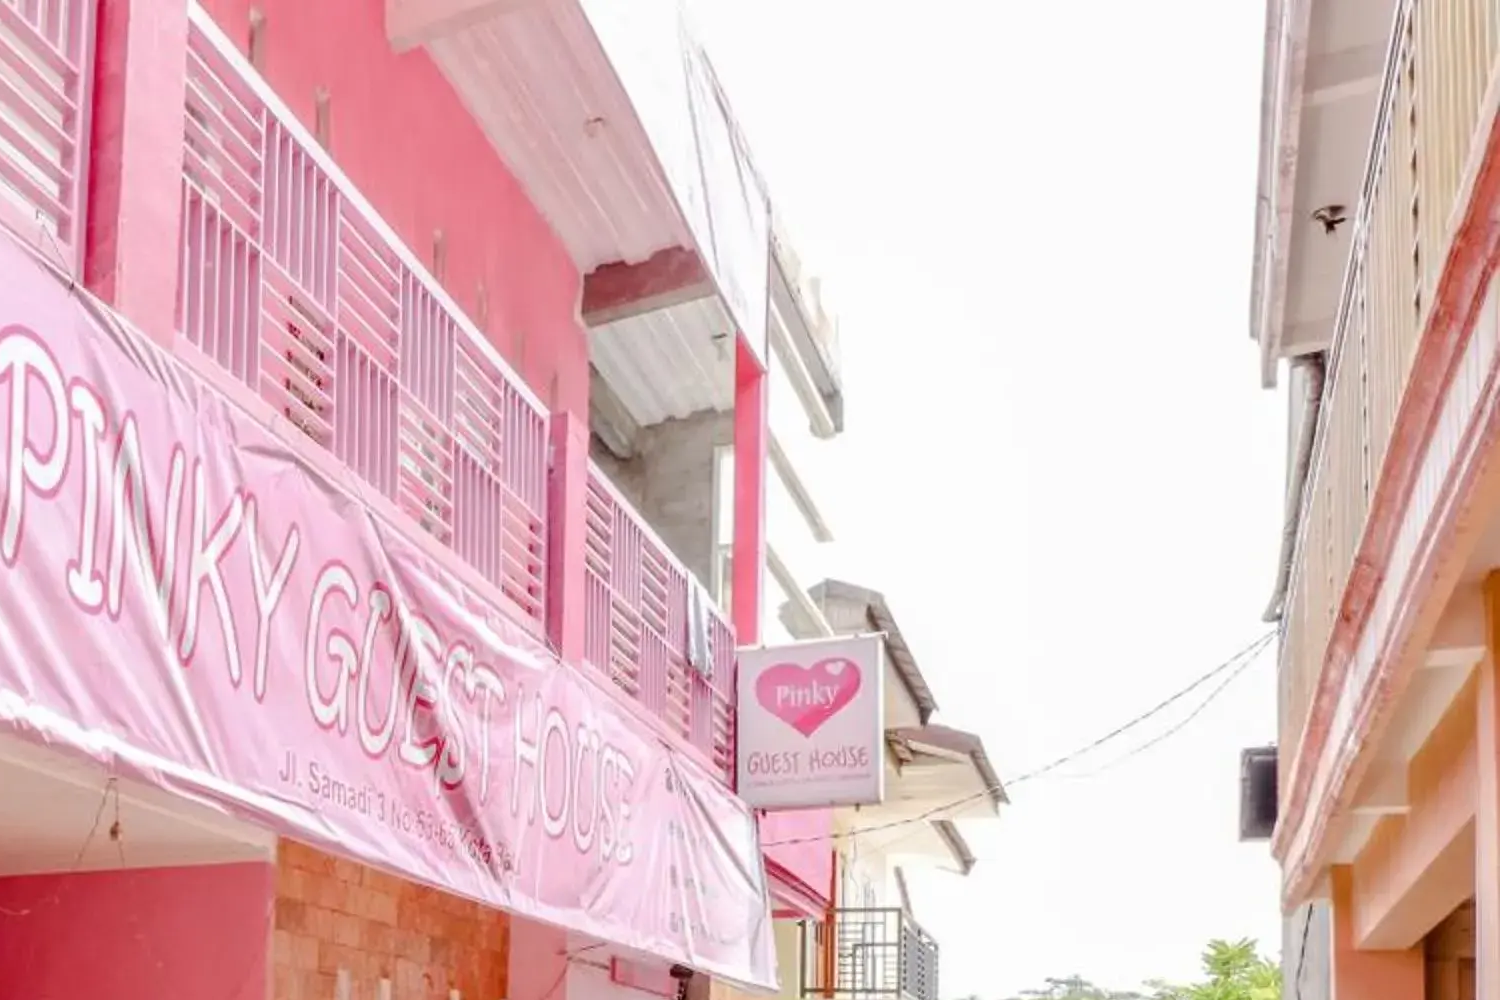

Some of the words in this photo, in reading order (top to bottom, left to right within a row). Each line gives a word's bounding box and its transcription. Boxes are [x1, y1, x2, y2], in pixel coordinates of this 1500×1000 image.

[305, 558, 506, 808] GUEST
[509, 682, 636, 867] HOUSE
[775, 679, 839, 709] Pinky
[279, 750, 302, 787] Jl.
[308, 761, 372, 819] Samadi
[747, 750, 800, 776] GUEST
[808, 744, 870, 774] HOUSE
